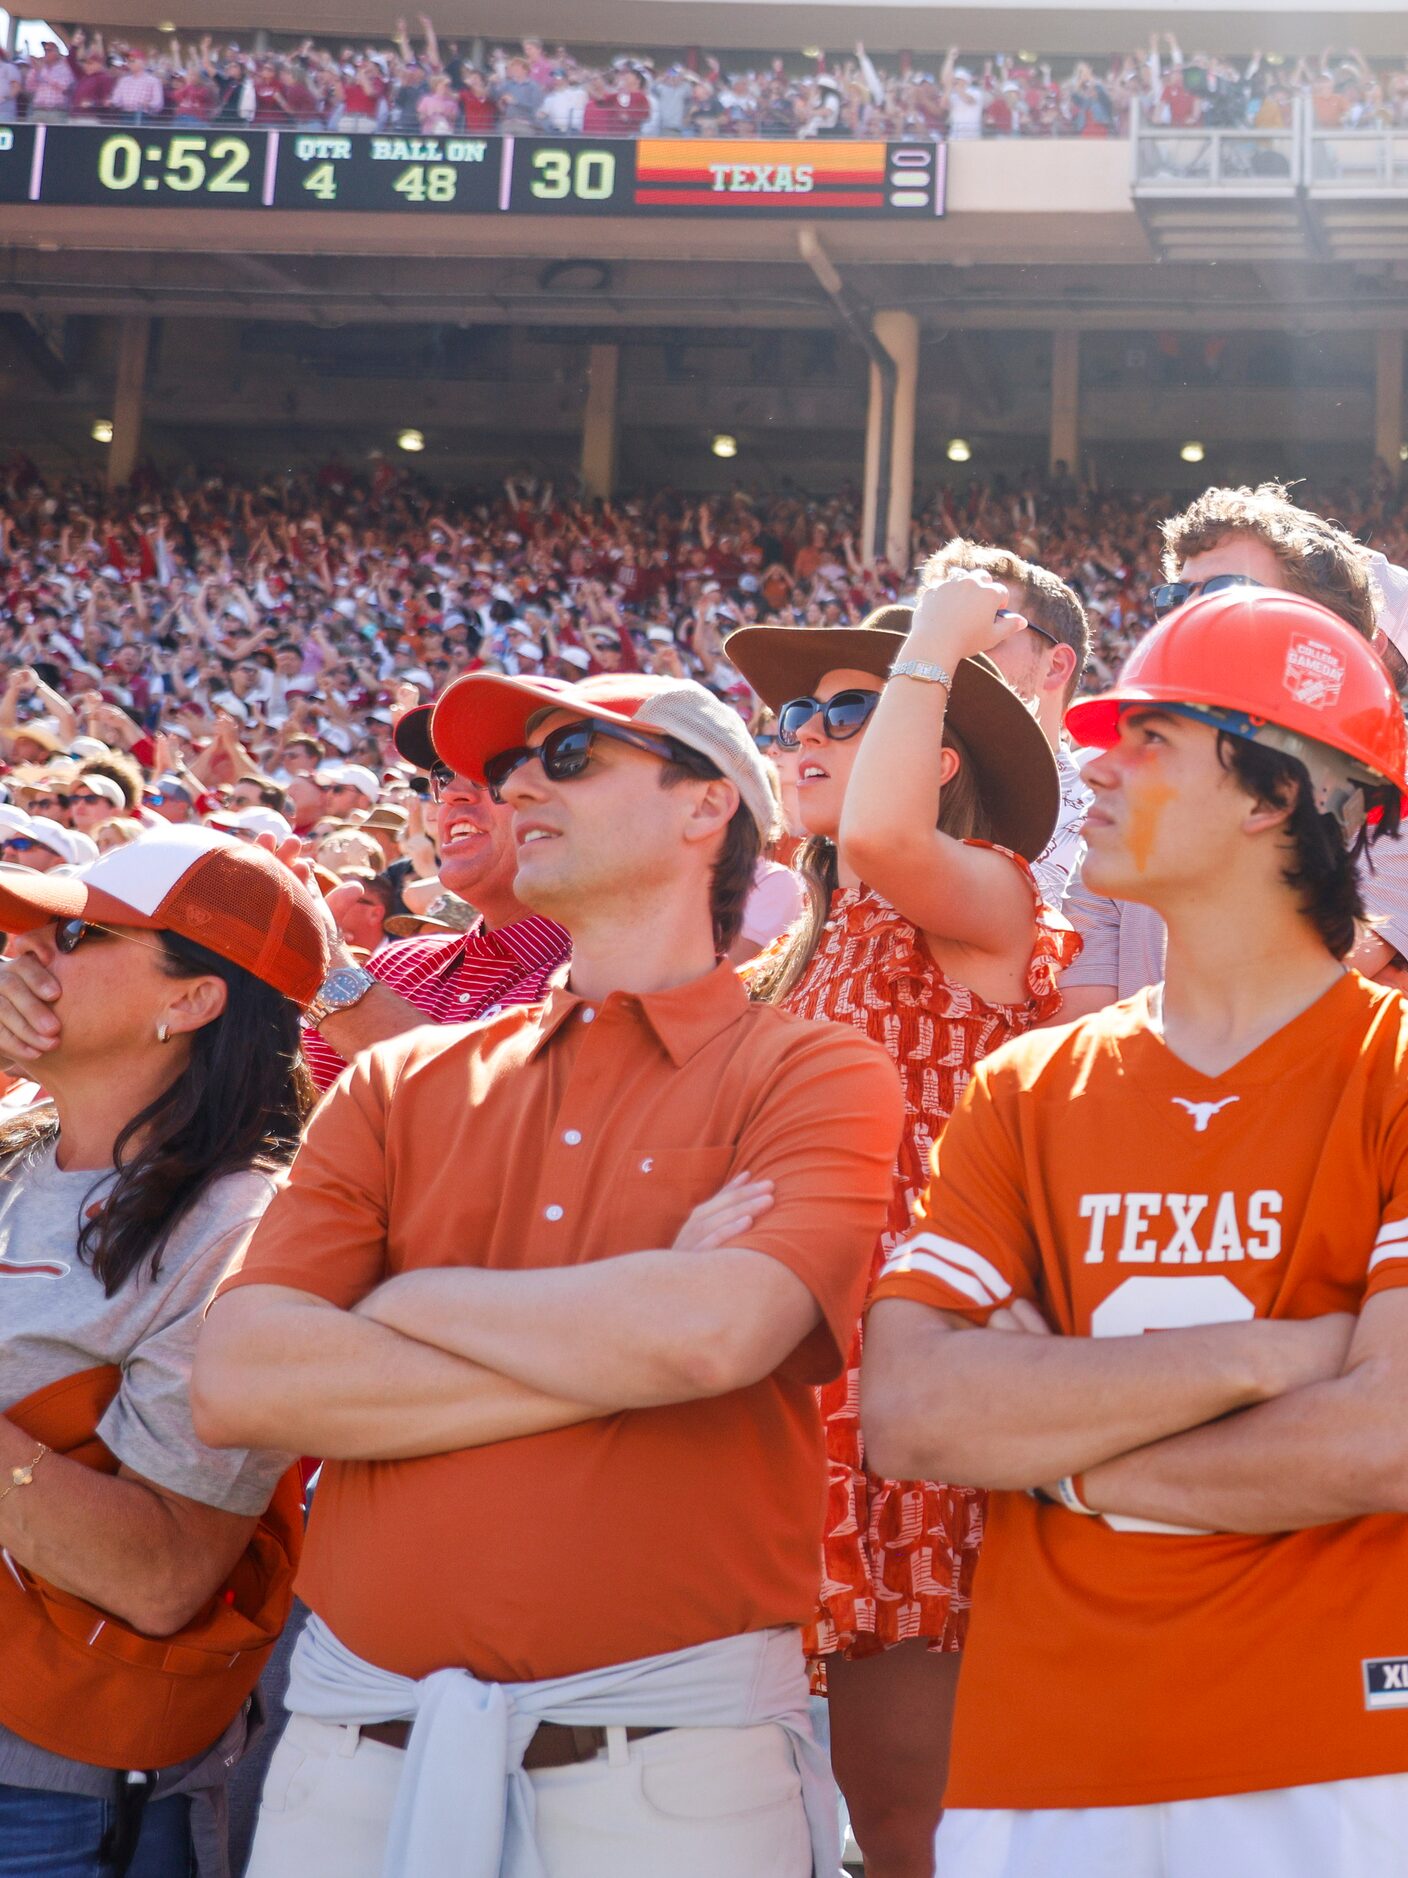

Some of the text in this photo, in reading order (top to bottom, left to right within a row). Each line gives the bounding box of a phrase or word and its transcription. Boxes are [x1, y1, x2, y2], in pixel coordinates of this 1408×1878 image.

[99, 135, 250, 193] 0:52
[296, 137, 352, 161] QTR
[371, 138, 487, 163] BALL ON
[304, 163, 337, 199] 4
[394, 166, 457, 202] 48
[531, 149, 616, 200] 30
[709, 164, 814, 193] TEXAS
[1079, 1189, 1283, 1264] TEXAS
